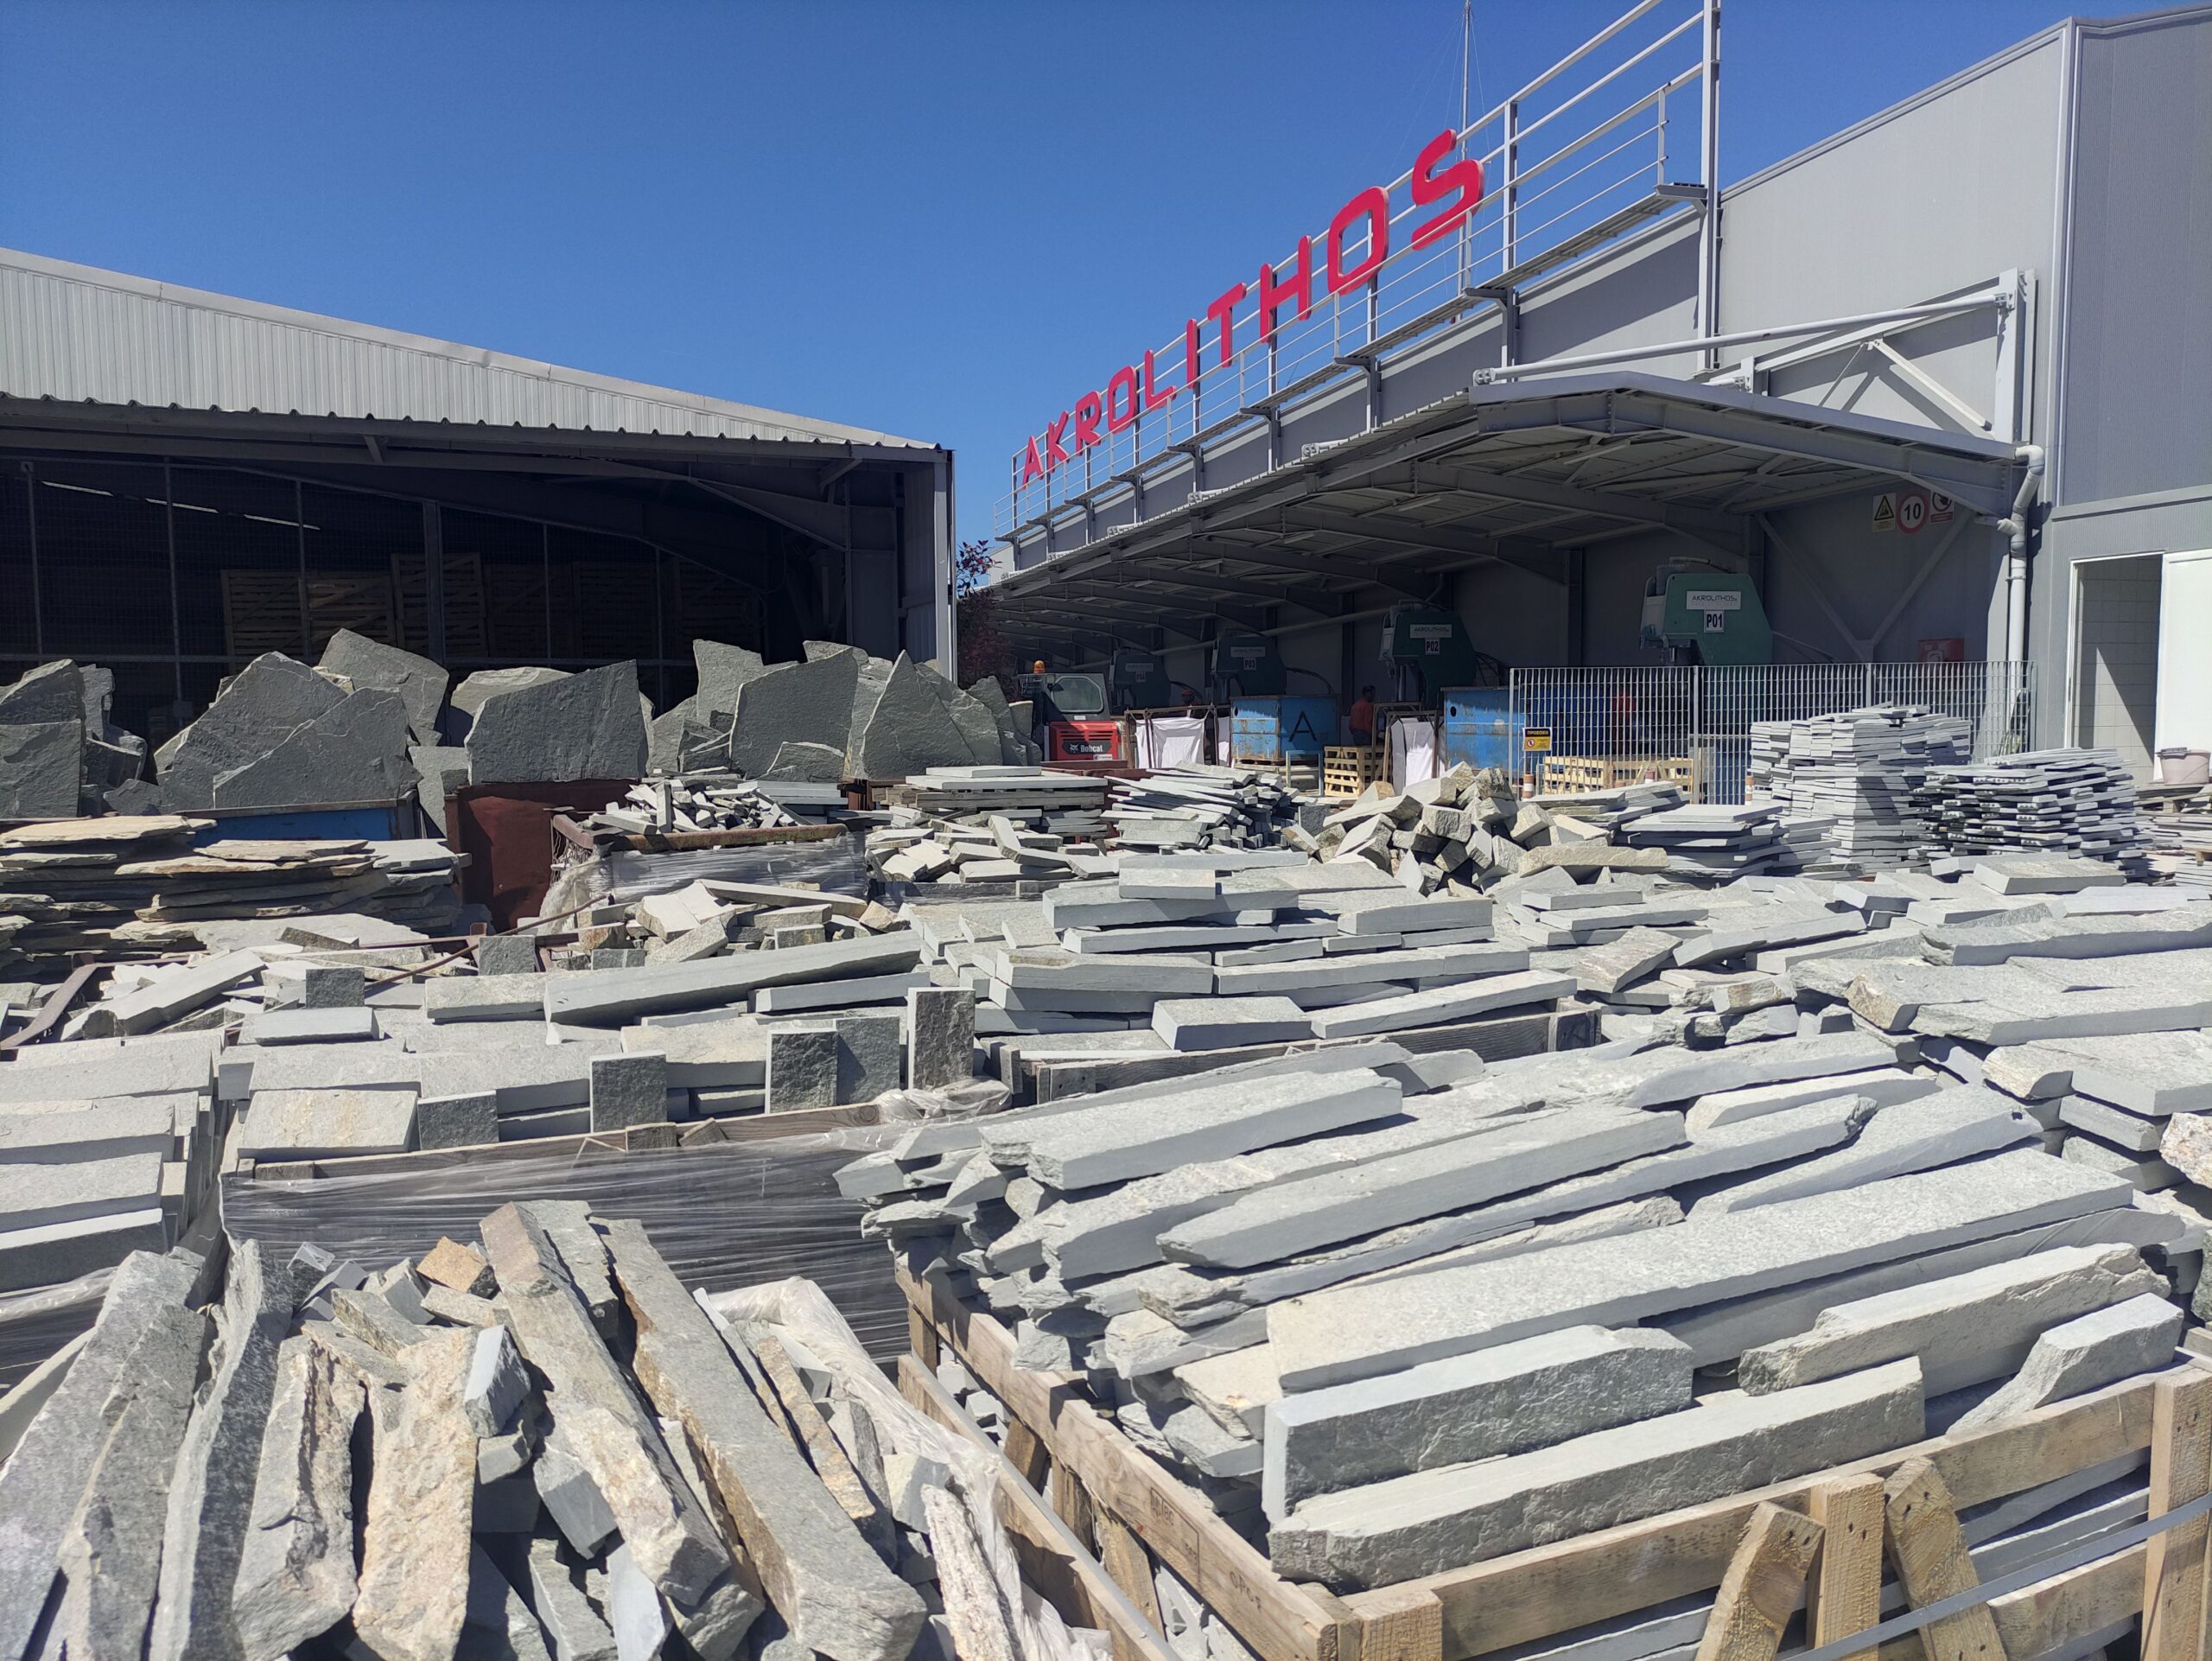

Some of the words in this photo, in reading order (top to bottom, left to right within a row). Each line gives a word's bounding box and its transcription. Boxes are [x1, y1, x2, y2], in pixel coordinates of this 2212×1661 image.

[1022, 128, 1484, 490] AKROLITHOS
[1904, 503, 1922, 521] 10
[1707, 614, 1723, 628] P01
[1426, 640, 1439, 652] P02
[1080, 744, 1103, 753] Bobcat
